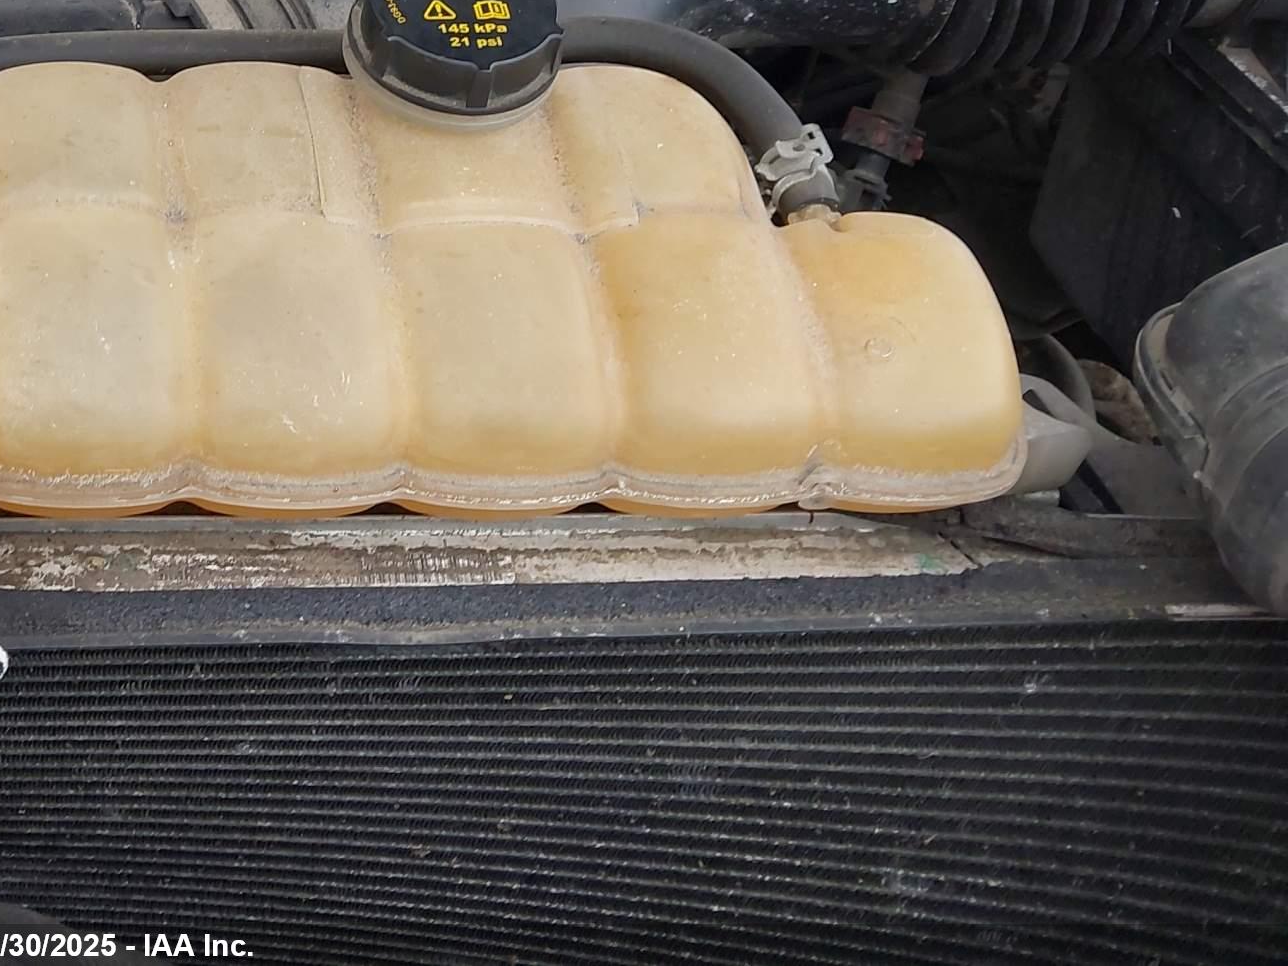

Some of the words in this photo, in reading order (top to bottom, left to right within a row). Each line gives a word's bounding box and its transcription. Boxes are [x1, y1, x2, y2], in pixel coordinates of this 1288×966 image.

[438, 22, 470, 34] 145
[474, 22, 508, 34] kPa
[449, 36, 469, 48] 21
[476, 36, 503, 49] psi
